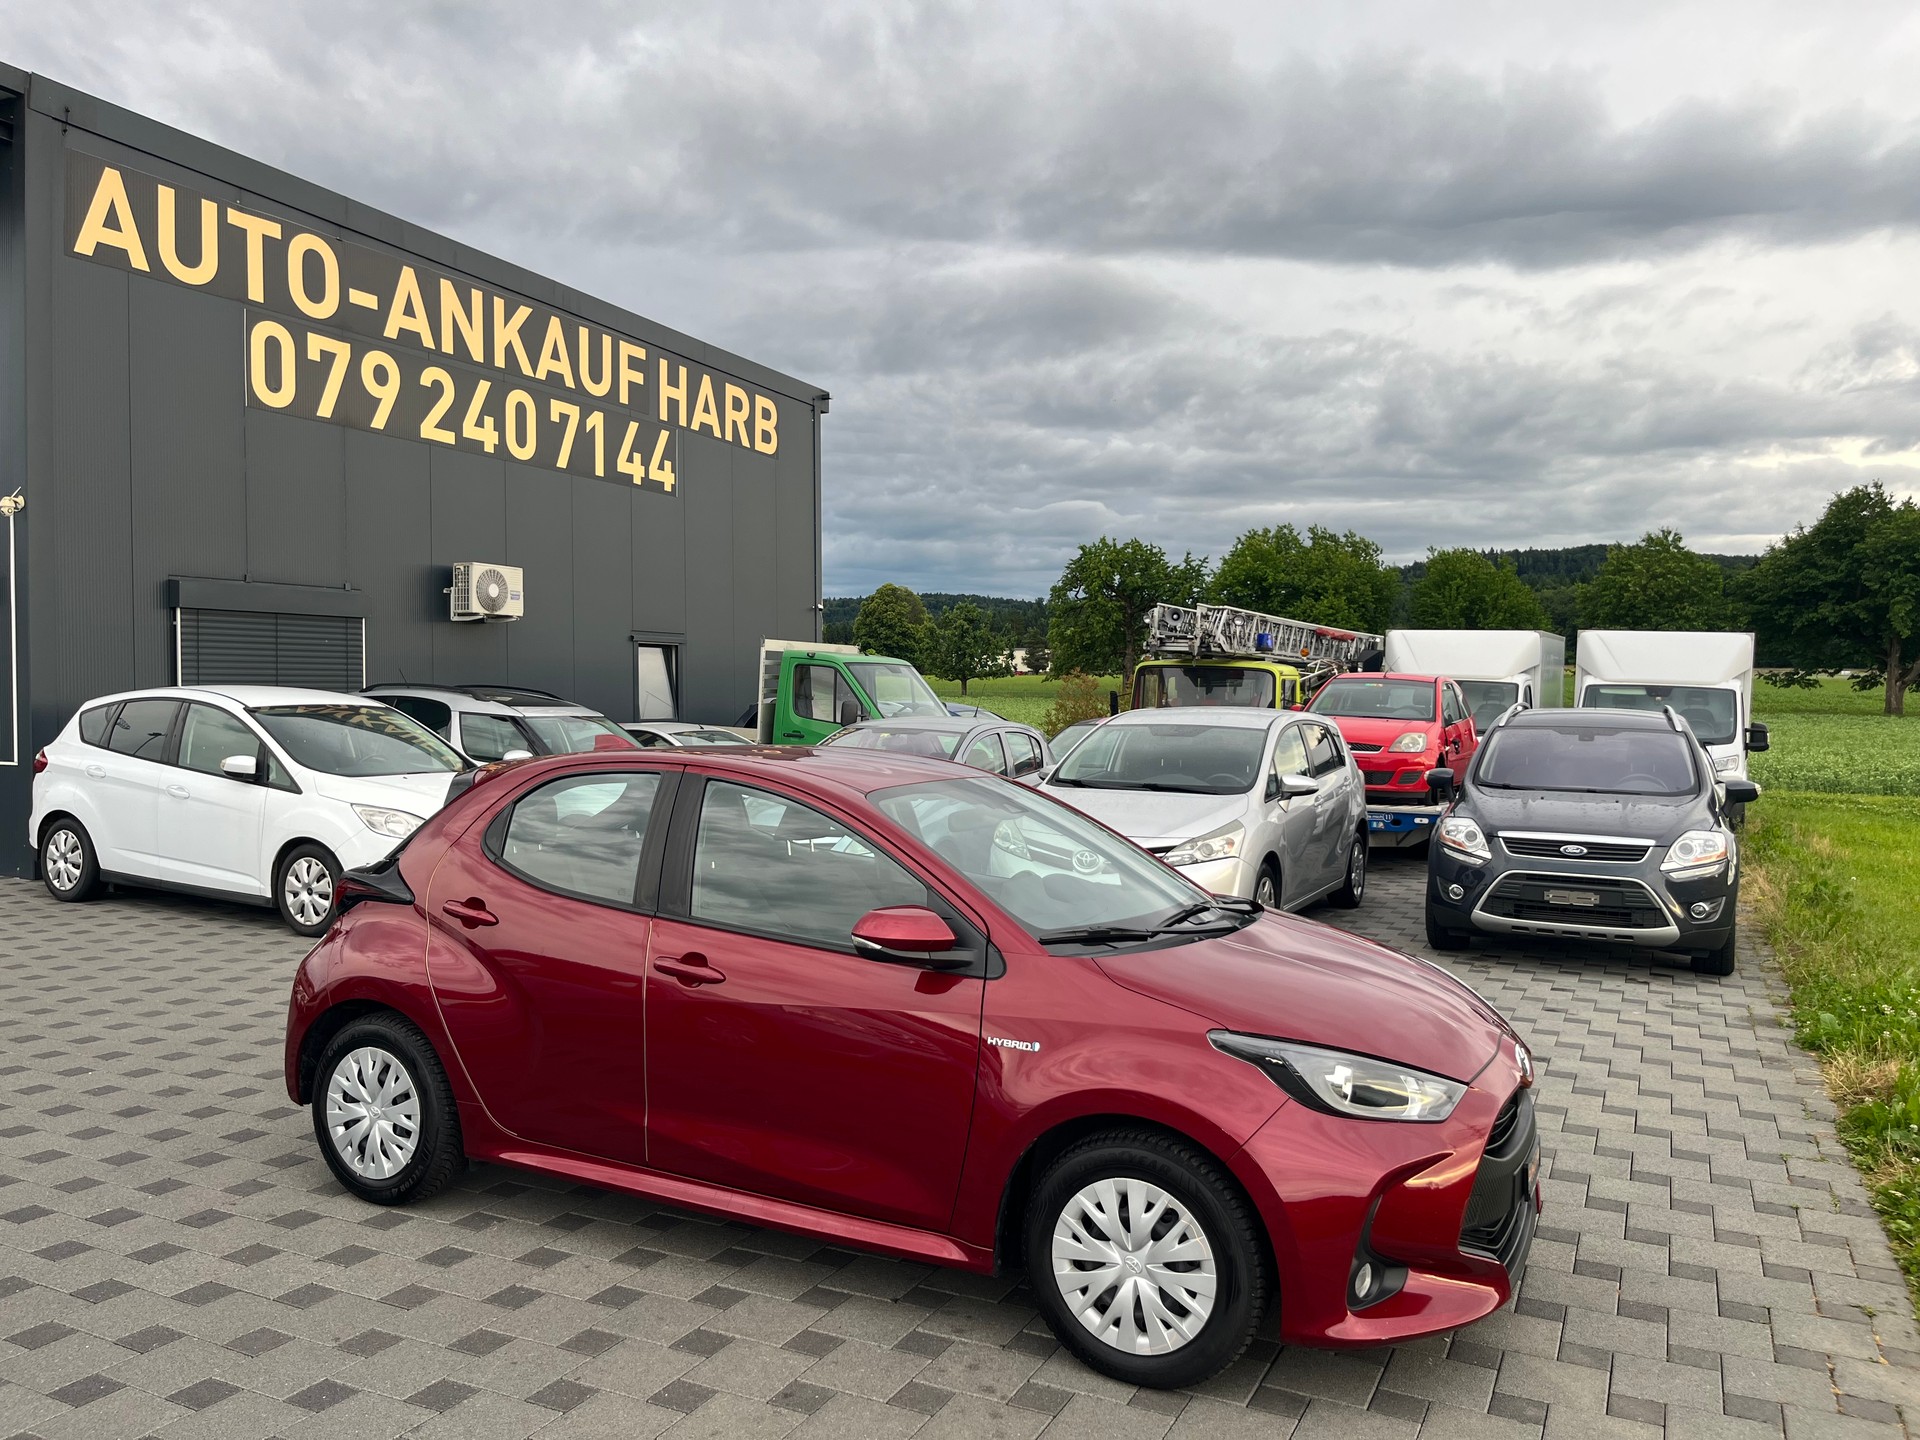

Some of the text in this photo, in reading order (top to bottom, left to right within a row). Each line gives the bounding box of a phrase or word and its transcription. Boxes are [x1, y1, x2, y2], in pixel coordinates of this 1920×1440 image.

[74, 166, 779, 456] AUTO-ANKAUF HARB
[250, 320, 401, 431] 079
[419, 366, 537, 462] 240
[987, 1036, 1032, 1051] HYBRID
